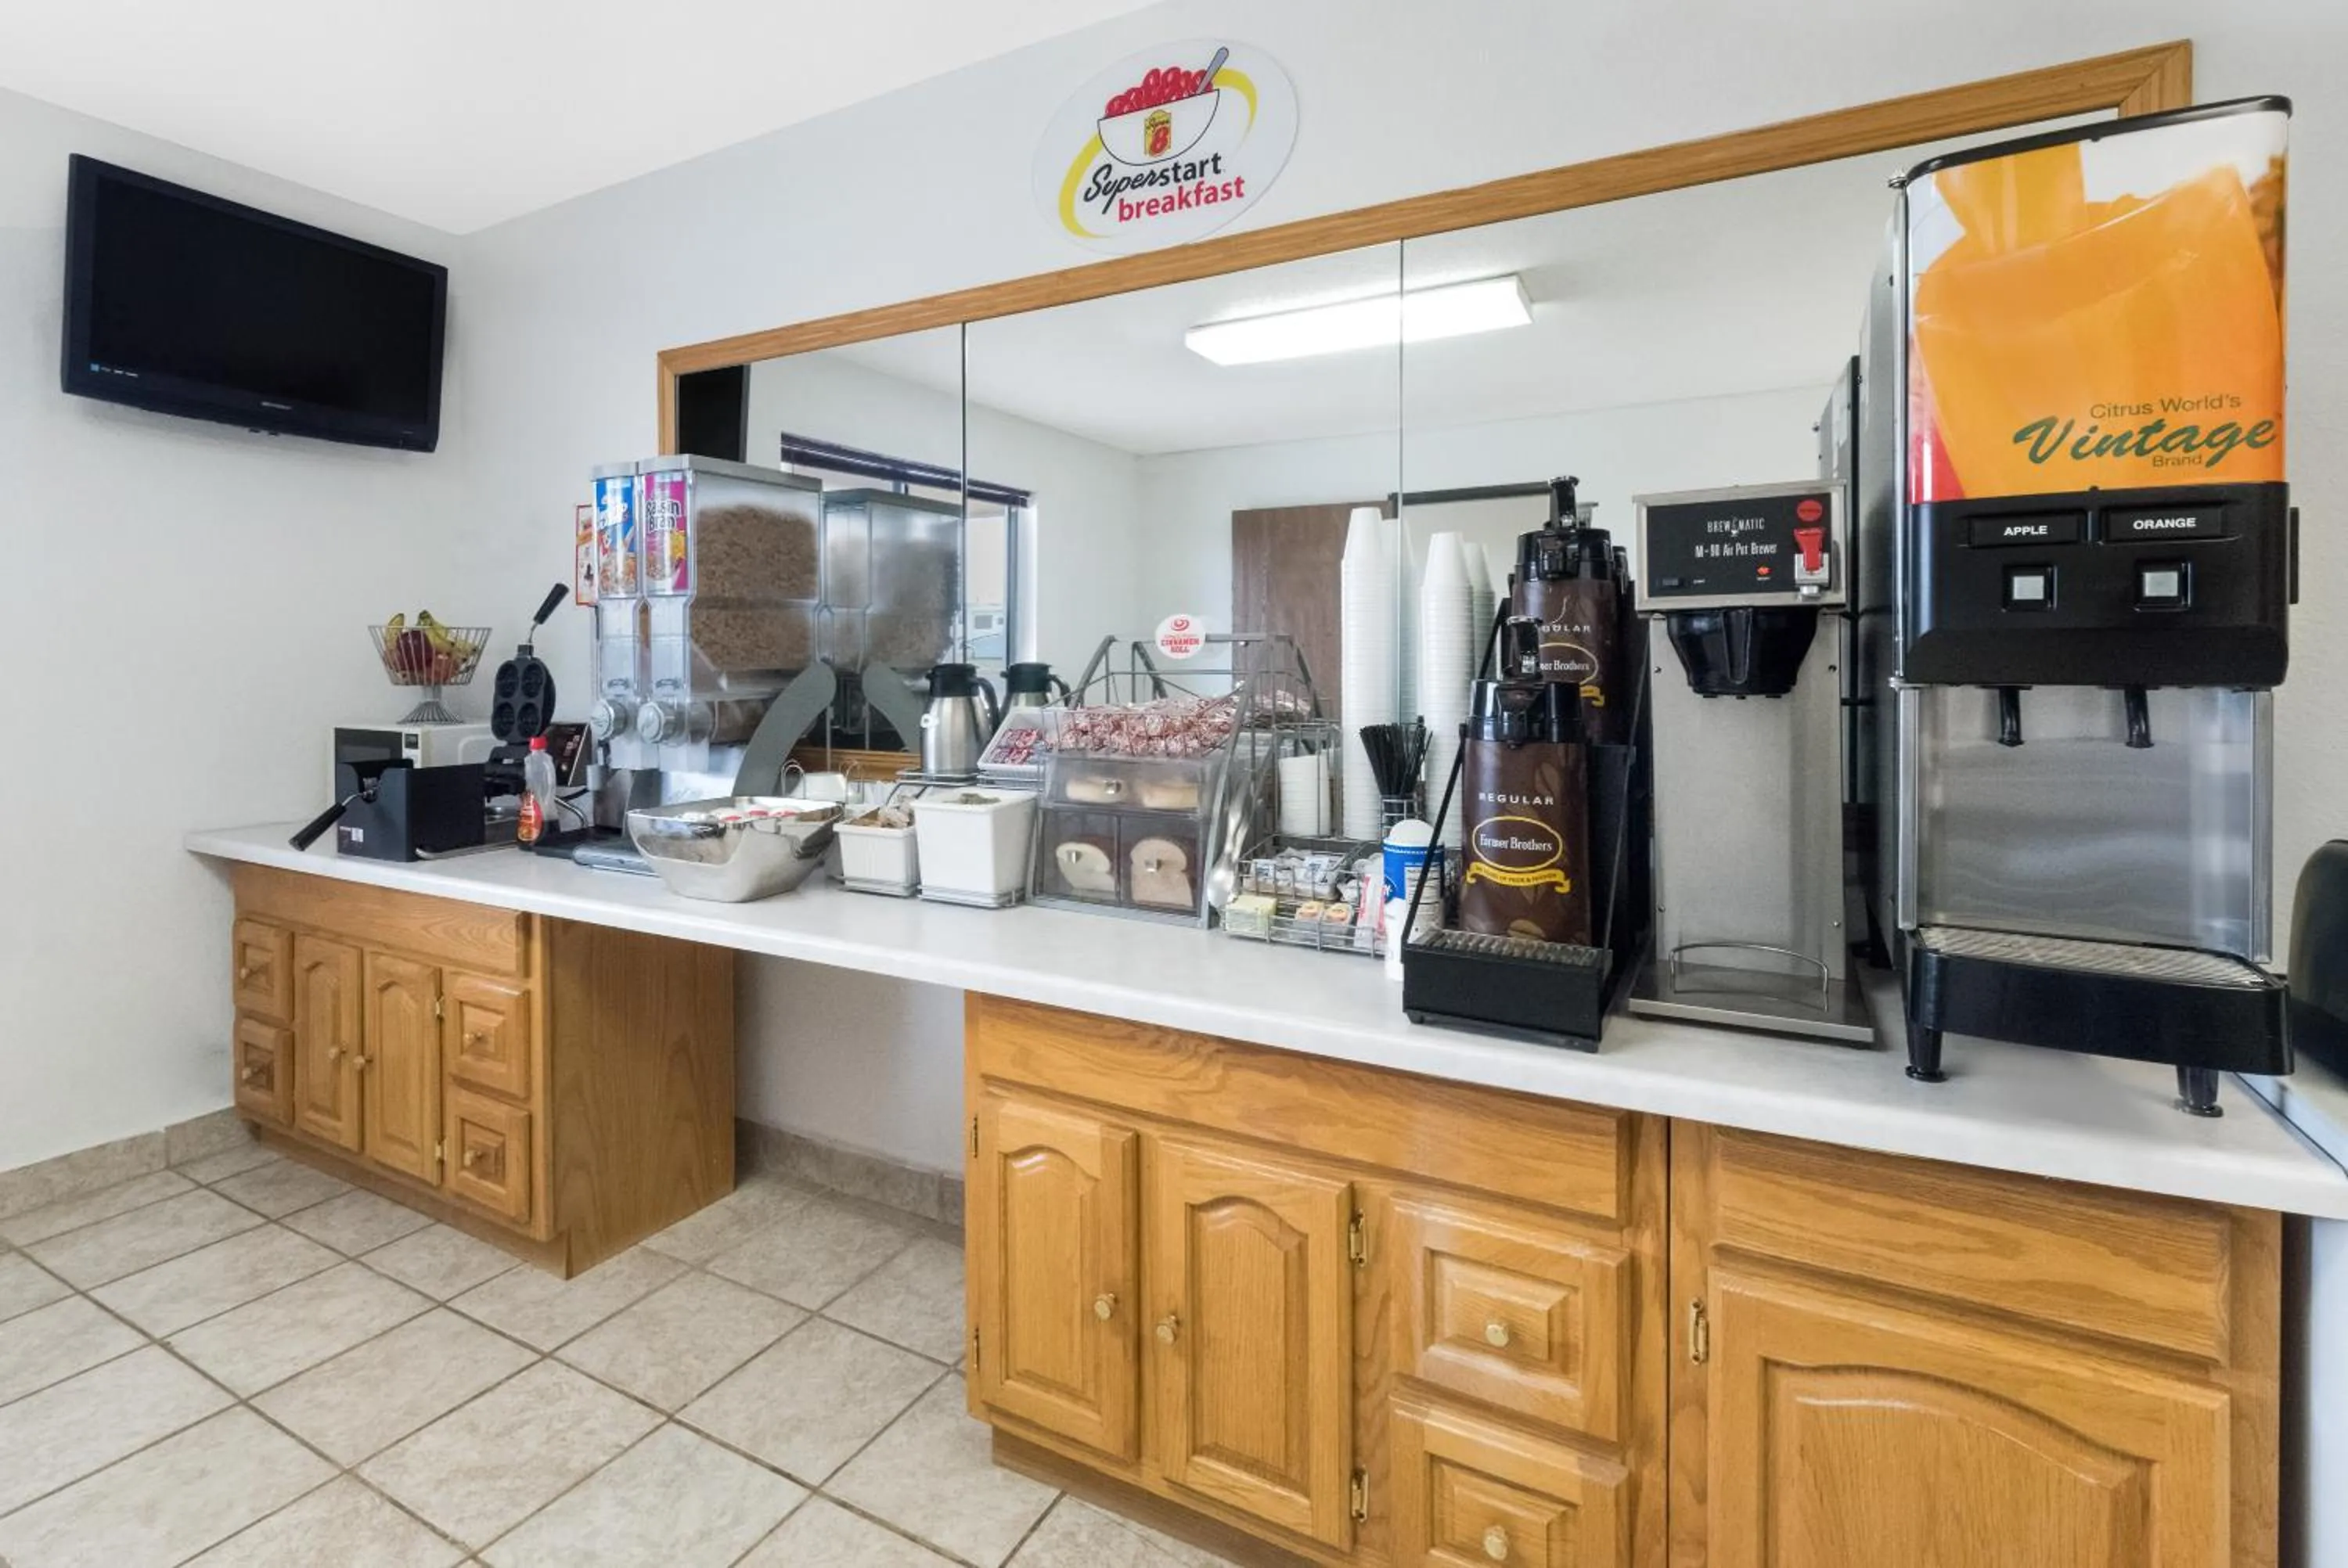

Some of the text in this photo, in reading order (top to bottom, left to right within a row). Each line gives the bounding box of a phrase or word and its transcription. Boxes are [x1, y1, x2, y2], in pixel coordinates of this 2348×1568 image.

[1083, 152, 1222, 214] Superstart
[1118, 175, 1245, 222] breakfast
[2090, 394, 2242, 419] Citrus World's
[2013, 415, 2277, 469] Vintage
[2152, 454, 2203, 469] Brand
[646, 501, 680, 517] Raisin
[650, 516, 675, 532] Bran
[2004, 525, 2048, 537] APPLE
[2133, 517, 2197, 530] ORANGE
[1751, 541, 1777, 555] Brewer
[1540, 624, 1591, 633] GULAR
[1478, 792, 1554, 805] REGULAR
[1479, 833, 1553, 852] Farmer Brothers
